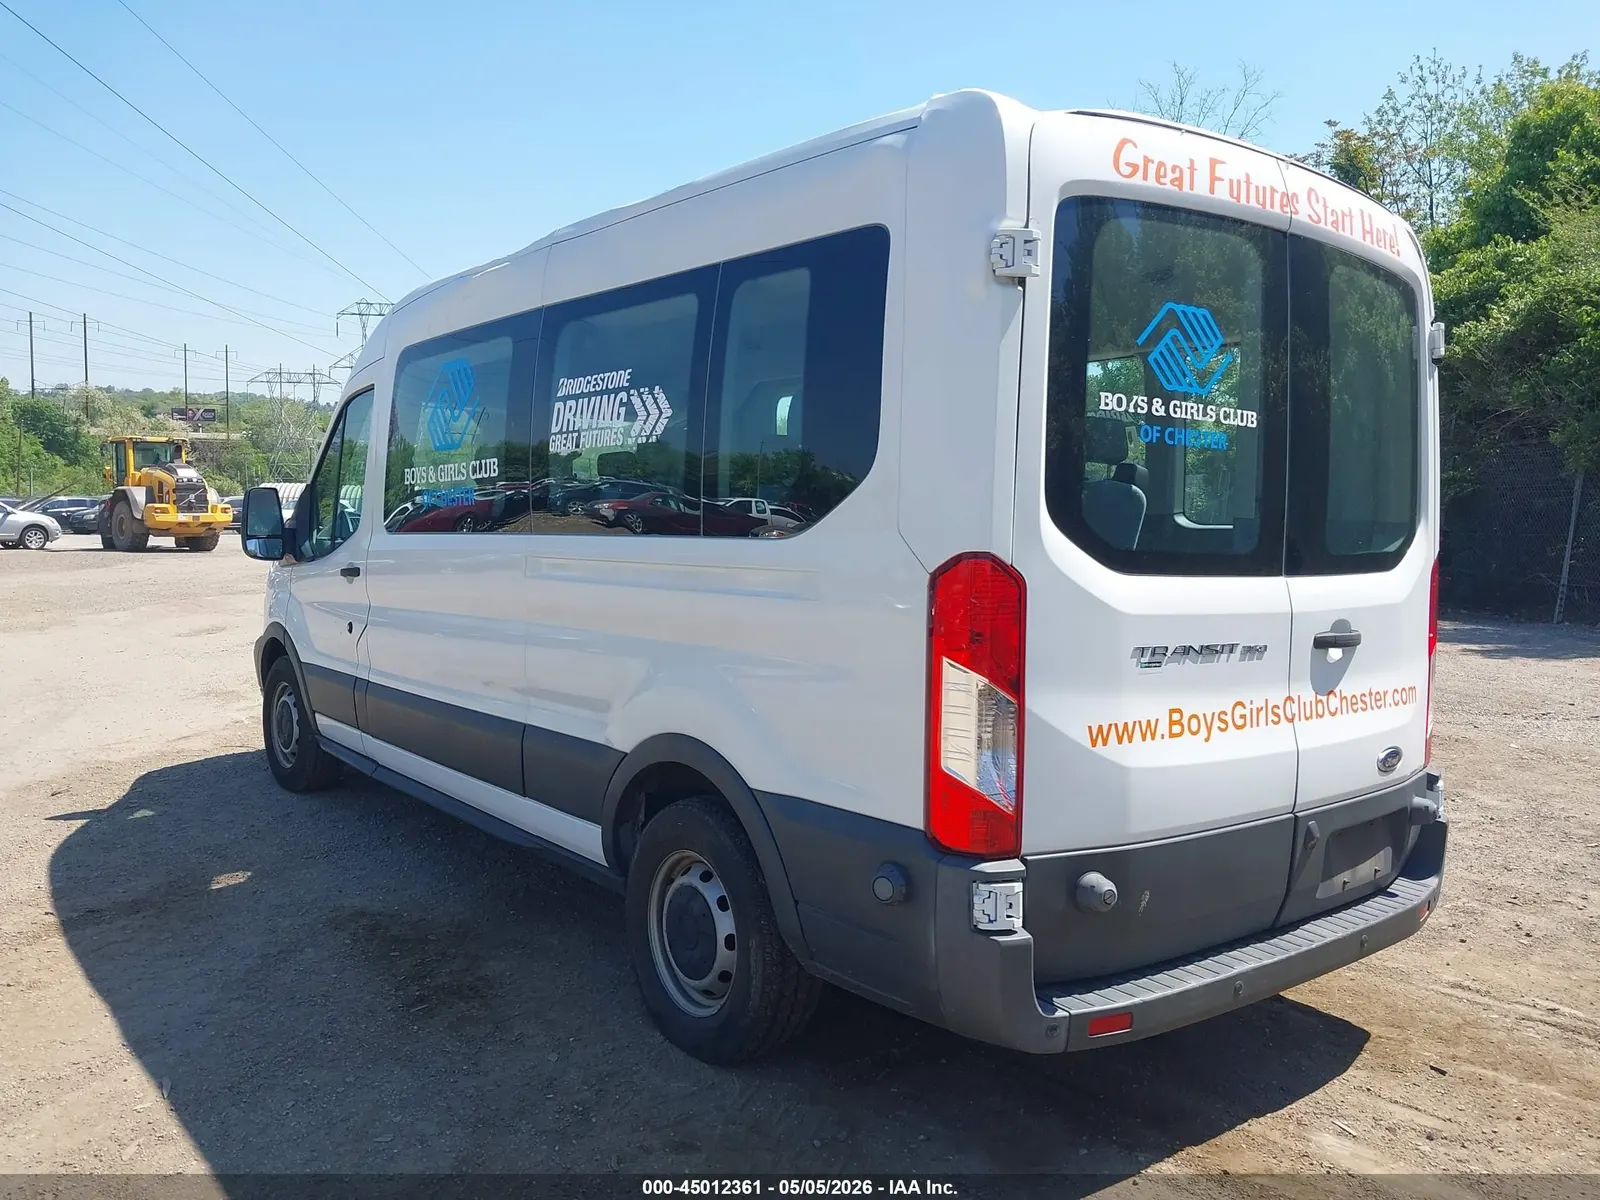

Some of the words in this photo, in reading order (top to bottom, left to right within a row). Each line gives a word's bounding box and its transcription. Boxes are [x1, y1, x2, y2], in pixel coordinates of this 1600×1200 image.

[1112, 137, 1198, 192] Great
[1208, 157, 1300, 216] Futures
[1306, 187, 1355, 237] Start
[1359, 208, 1401, 258] Here!
[556, 368, 633, 397] BRIDGESTONE
[551, 391, 628, 434] DRIVING
[1151, 397, 1167, 417] &
[1168, 400, 1216, 422] GIRLS
[1219, 407, 1258, 429] CLUB
[549, 432, 578, 454] GREAT
[580, 427, 624, 449] FUTURES
[1139, 424, 1161, 443] OF
[1164, 427, 1228, 450] CHESTER
[404, 466, 427, 485] BOYS
[428, 465, 436, 483] &
[437, 462, 467, 483] GIRLS
[469, 457, 499, 480] CLUB
[1133, 642, 1240, 658] TRANSIT
[1087, 684, 1418, 749] www.BoysGirlsClubChester.com
